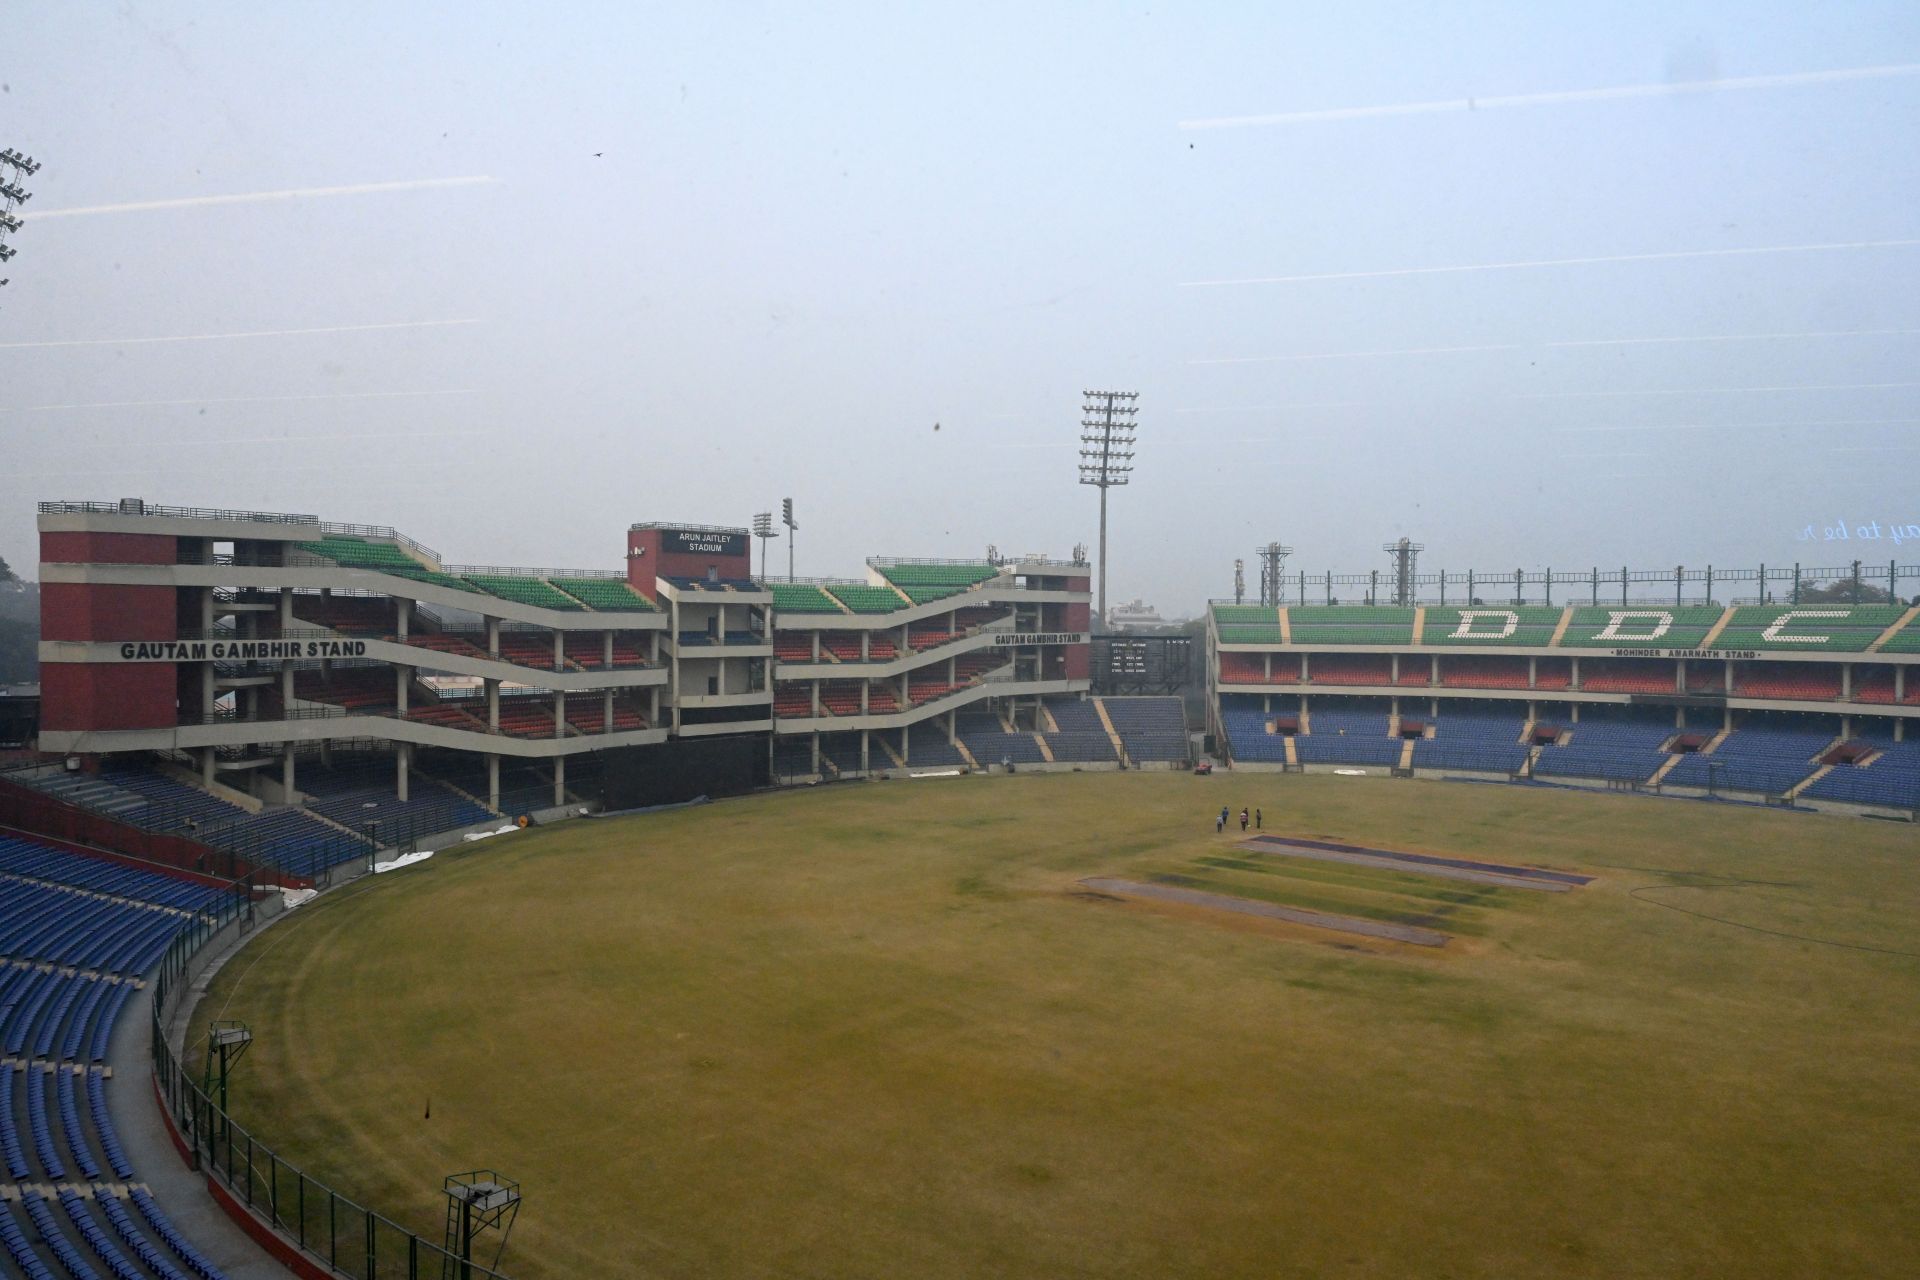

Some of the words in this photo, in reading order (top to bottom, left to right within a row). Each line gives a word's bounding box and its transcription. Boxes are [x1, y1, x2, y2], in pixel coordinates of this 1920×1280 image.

[679, 532, 701, 541] ARUN
[702, 534, 731, 543] JAITLEY
[689, 543, 722, 552] STADIUM
[995, 634, 1026, 645] GAUTAM
[1026, 634, 1058, 644] GAMBHIR
[1059, 634, 1081, 643] STAND
[121, 642, 207, 659] GAUTAM
[211, 642, 303, 659] GAMBHIR
[307, 641, 366, 657] STAND
[1616, 649, 1661, 657] MOHINDER
[1668, 649, 1719, 658] AMARNATH
[1725, 651, 1756, 659] STAND
